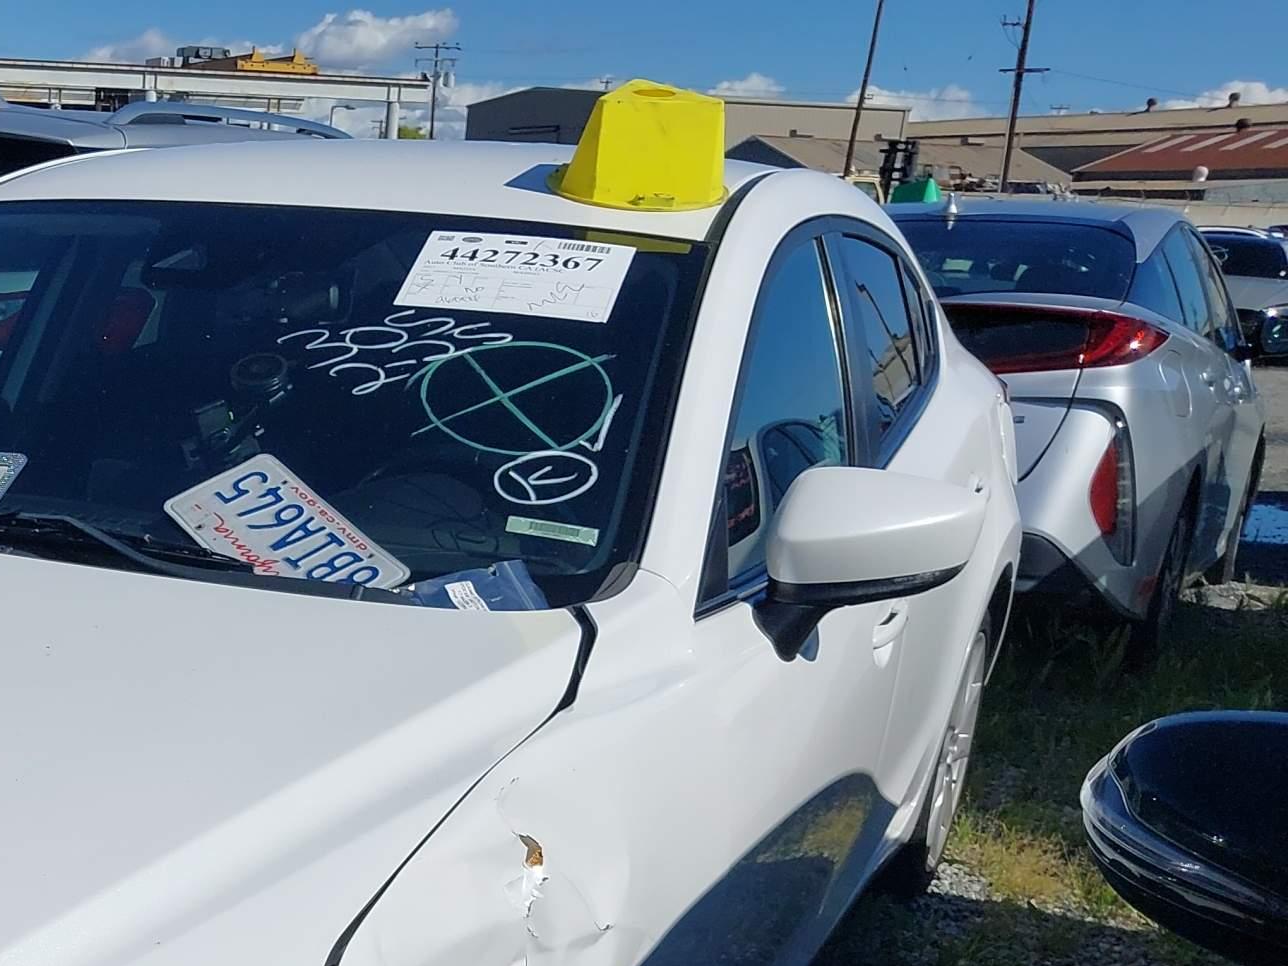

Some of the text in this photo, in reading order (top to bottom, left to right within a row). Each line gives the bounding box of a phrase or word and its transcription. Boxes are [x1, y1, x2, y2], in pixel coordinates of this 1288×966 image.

[440, 247, 603, 272] 44272367
[479, 262, 516, 270] Southern
[289, 486, 368, 551] dmv.ca.gov
